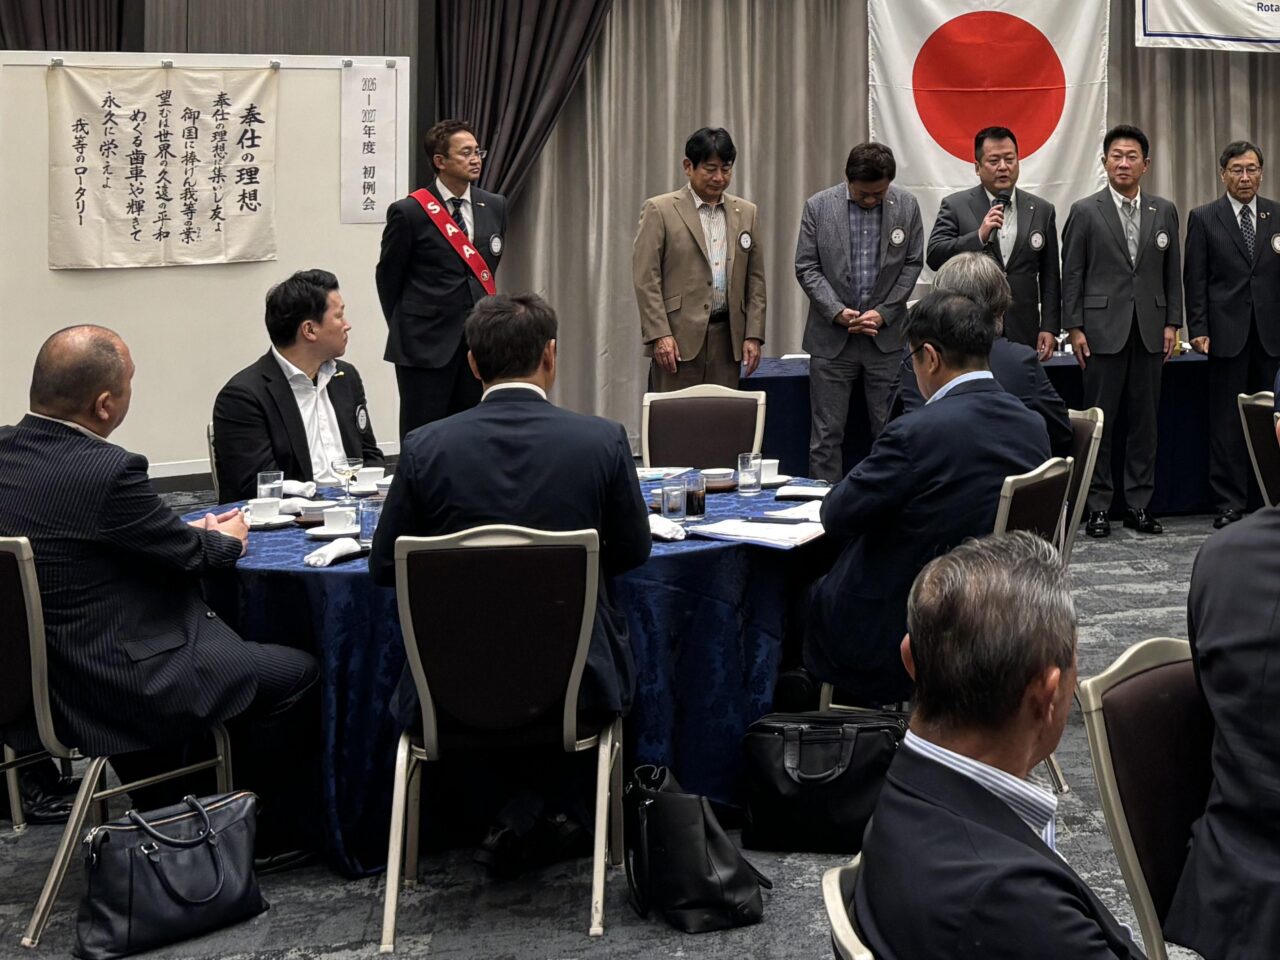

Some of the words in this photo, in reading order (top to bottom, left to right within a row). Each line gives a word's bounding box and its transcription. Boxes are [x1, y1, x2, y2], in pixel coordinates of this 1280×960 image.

[72, 117, 90, 226] 我等のロータリー
[100, 91, 122, 189] 永久に栄えよ
[125, 109, 148, 242] めぐる歯車いや輝きて
[152, 90, 177, 242] 望むは世界の久遠の平和
[208, 91, 232, 232] 奉仕の理想に集いし友よ
[235, 103, 265, 212] 奉仕の理想
[362, 166, 376, 211] 初例会
[427, 201, 476, 259] SAA
